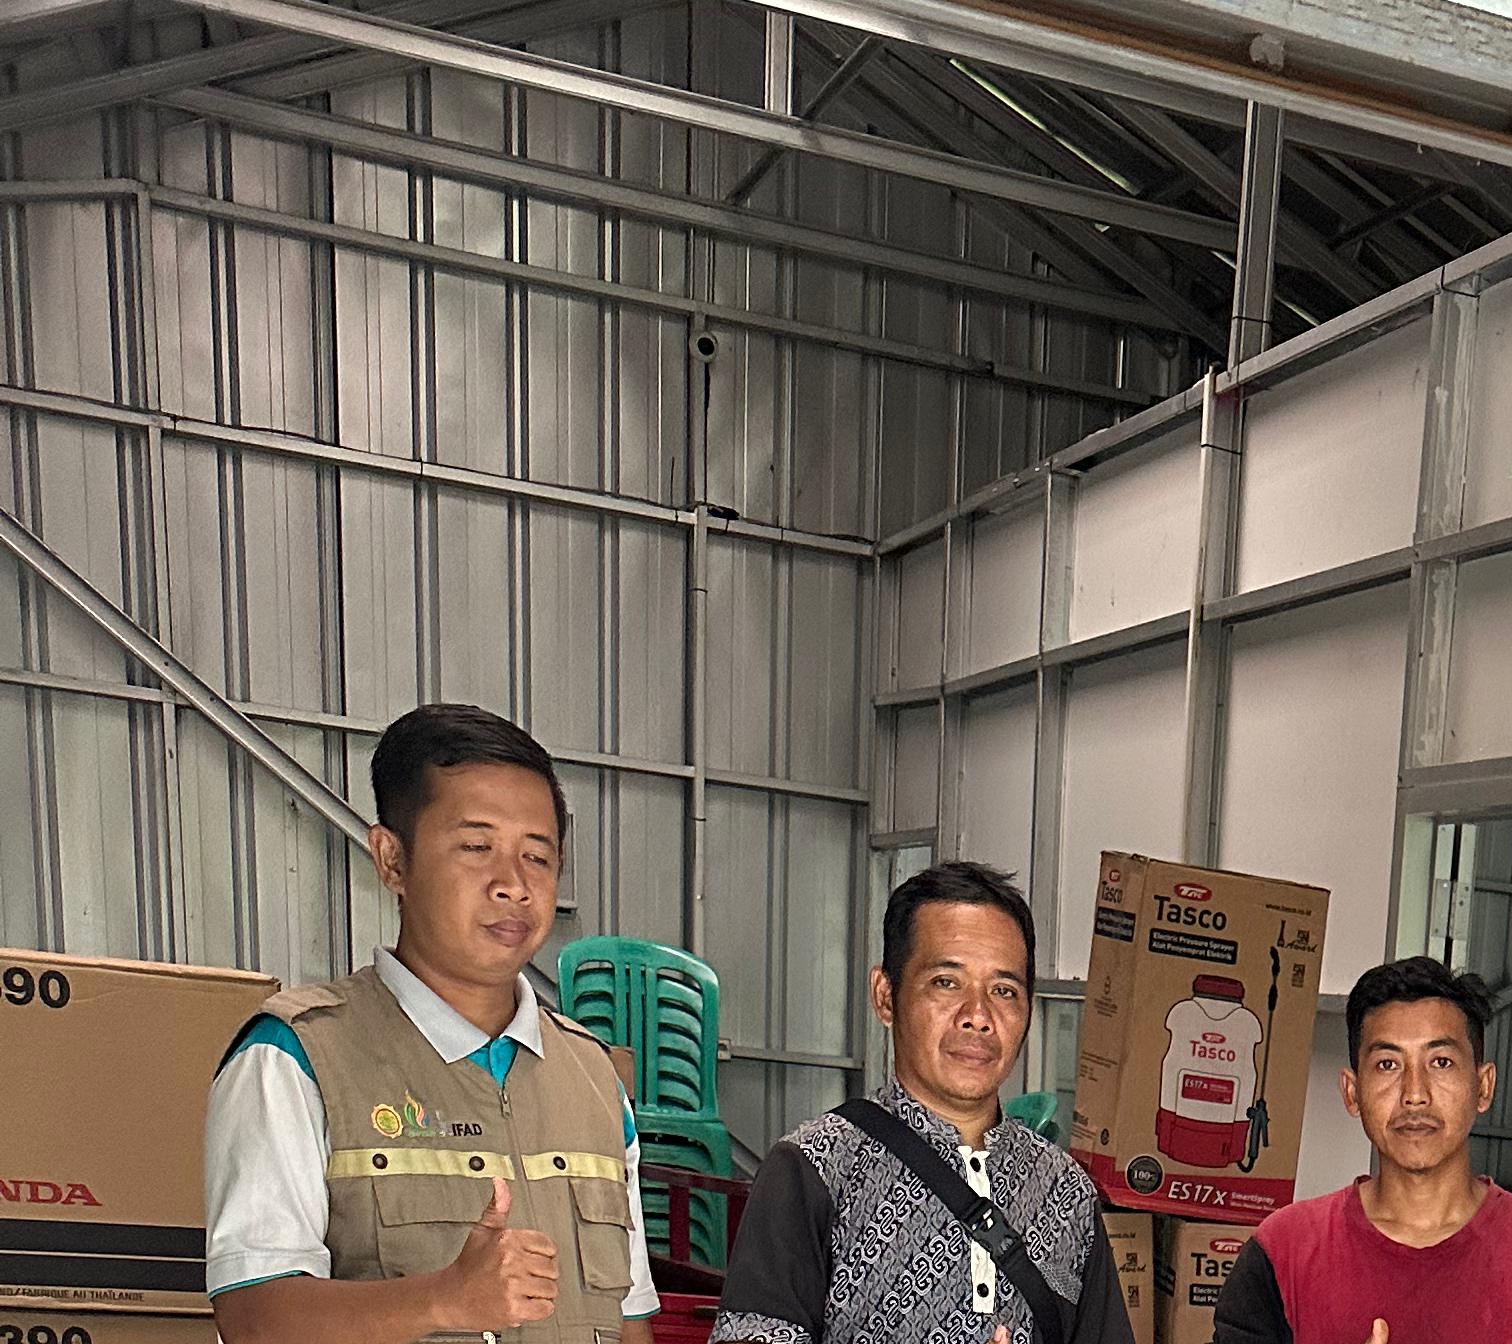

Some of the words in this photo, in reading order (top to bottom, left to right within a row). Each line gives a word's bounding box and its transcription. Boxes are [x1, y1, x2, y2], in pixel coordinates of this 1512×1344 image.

[1153, 895, 1227, 931] Tasco
[0, 966, 72, 1010] 90
[1190, 1040, 1236, 1062] Tasco
[451, 1123, 483, 1137] IFAD
[0, 1179, 102, 1208] NDA
[1191, 1252, 1236, 1277] Tas
